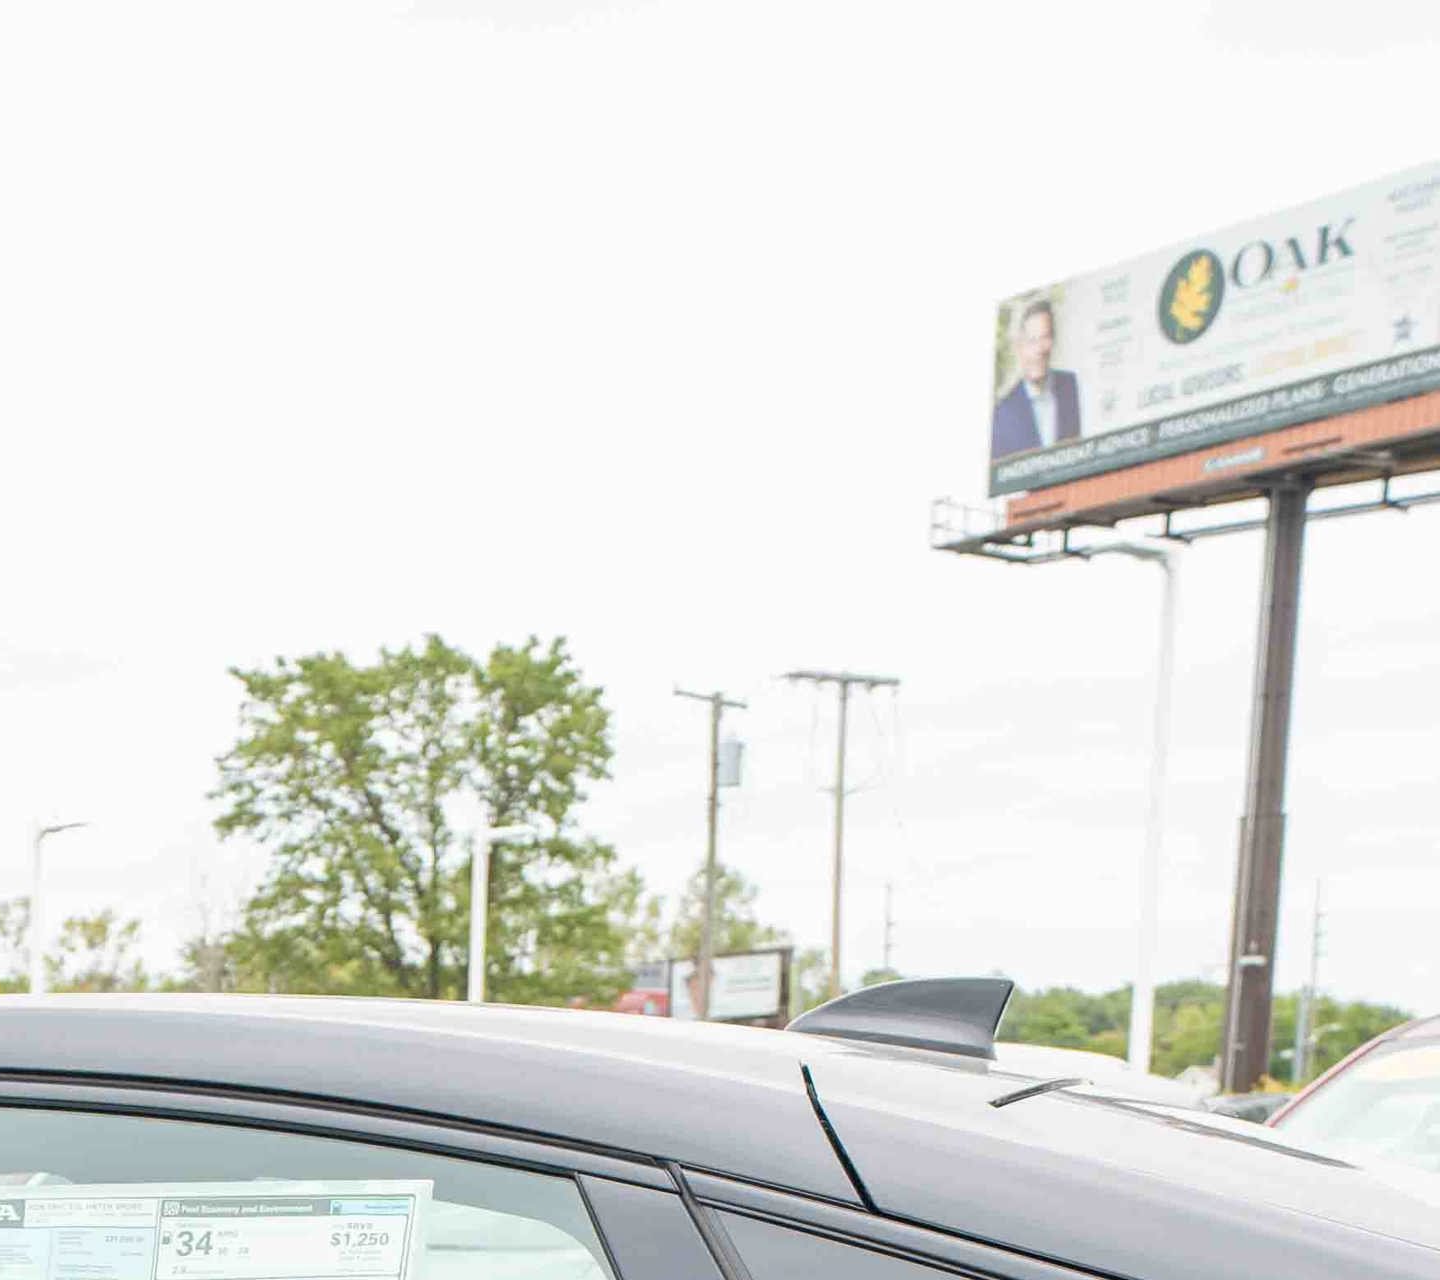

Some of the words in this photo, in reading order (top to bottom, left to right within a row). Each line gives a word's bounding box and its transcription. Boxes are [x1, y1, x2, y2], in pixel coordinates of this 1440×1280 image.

[1231, 217, 1358, 290] OAK
[997, 439, 1095, 483] INDEPENDENT
[1096, 425, 1149, 457] ADVICE
[1159, 394, 1269, 441] PERSONALIZED
[1272, 376, 1329, 410] PLANS
[176, 1229, 214, 1257] 34
[329, 1231, 390, 1248] $1,250
